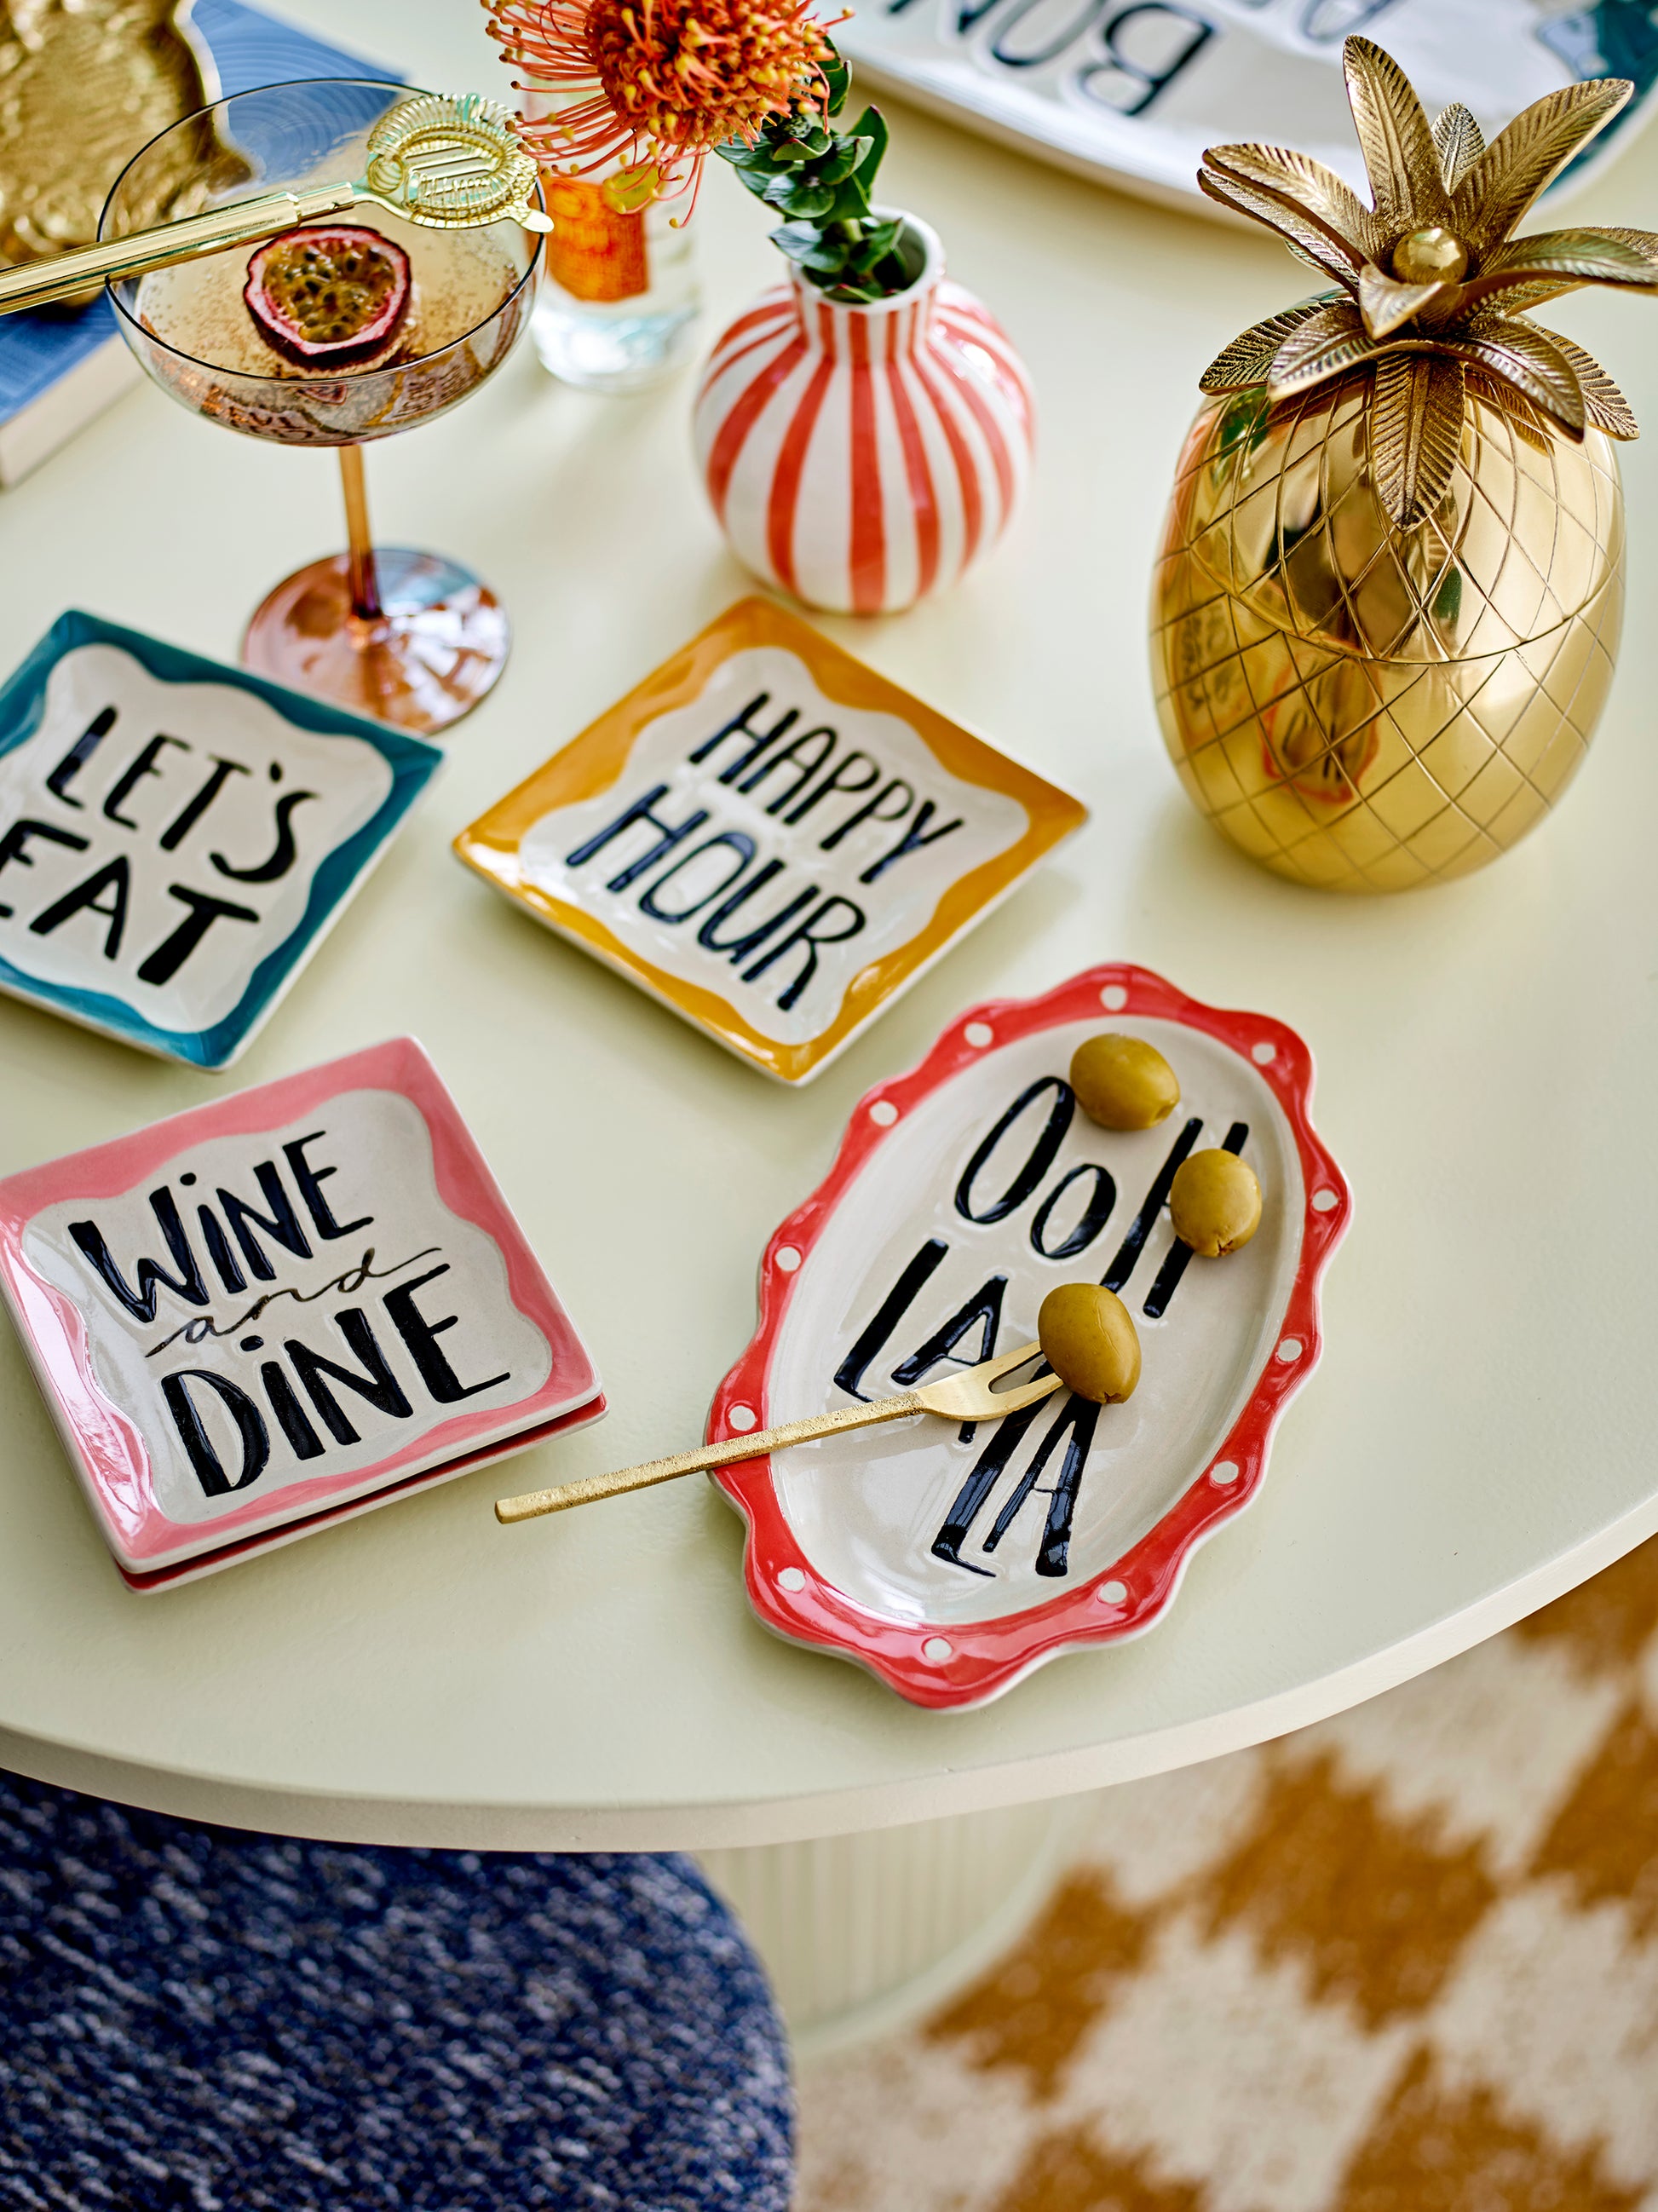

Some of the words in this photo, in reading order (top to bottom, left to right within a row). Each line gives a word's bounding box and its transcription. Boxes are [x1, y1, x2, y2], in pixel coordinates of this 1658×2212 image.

[46, 706, 320, 884] LET'S
[688, 692, 964, 884] HAPPY
[565, 784, 866, 1011] HOUR
